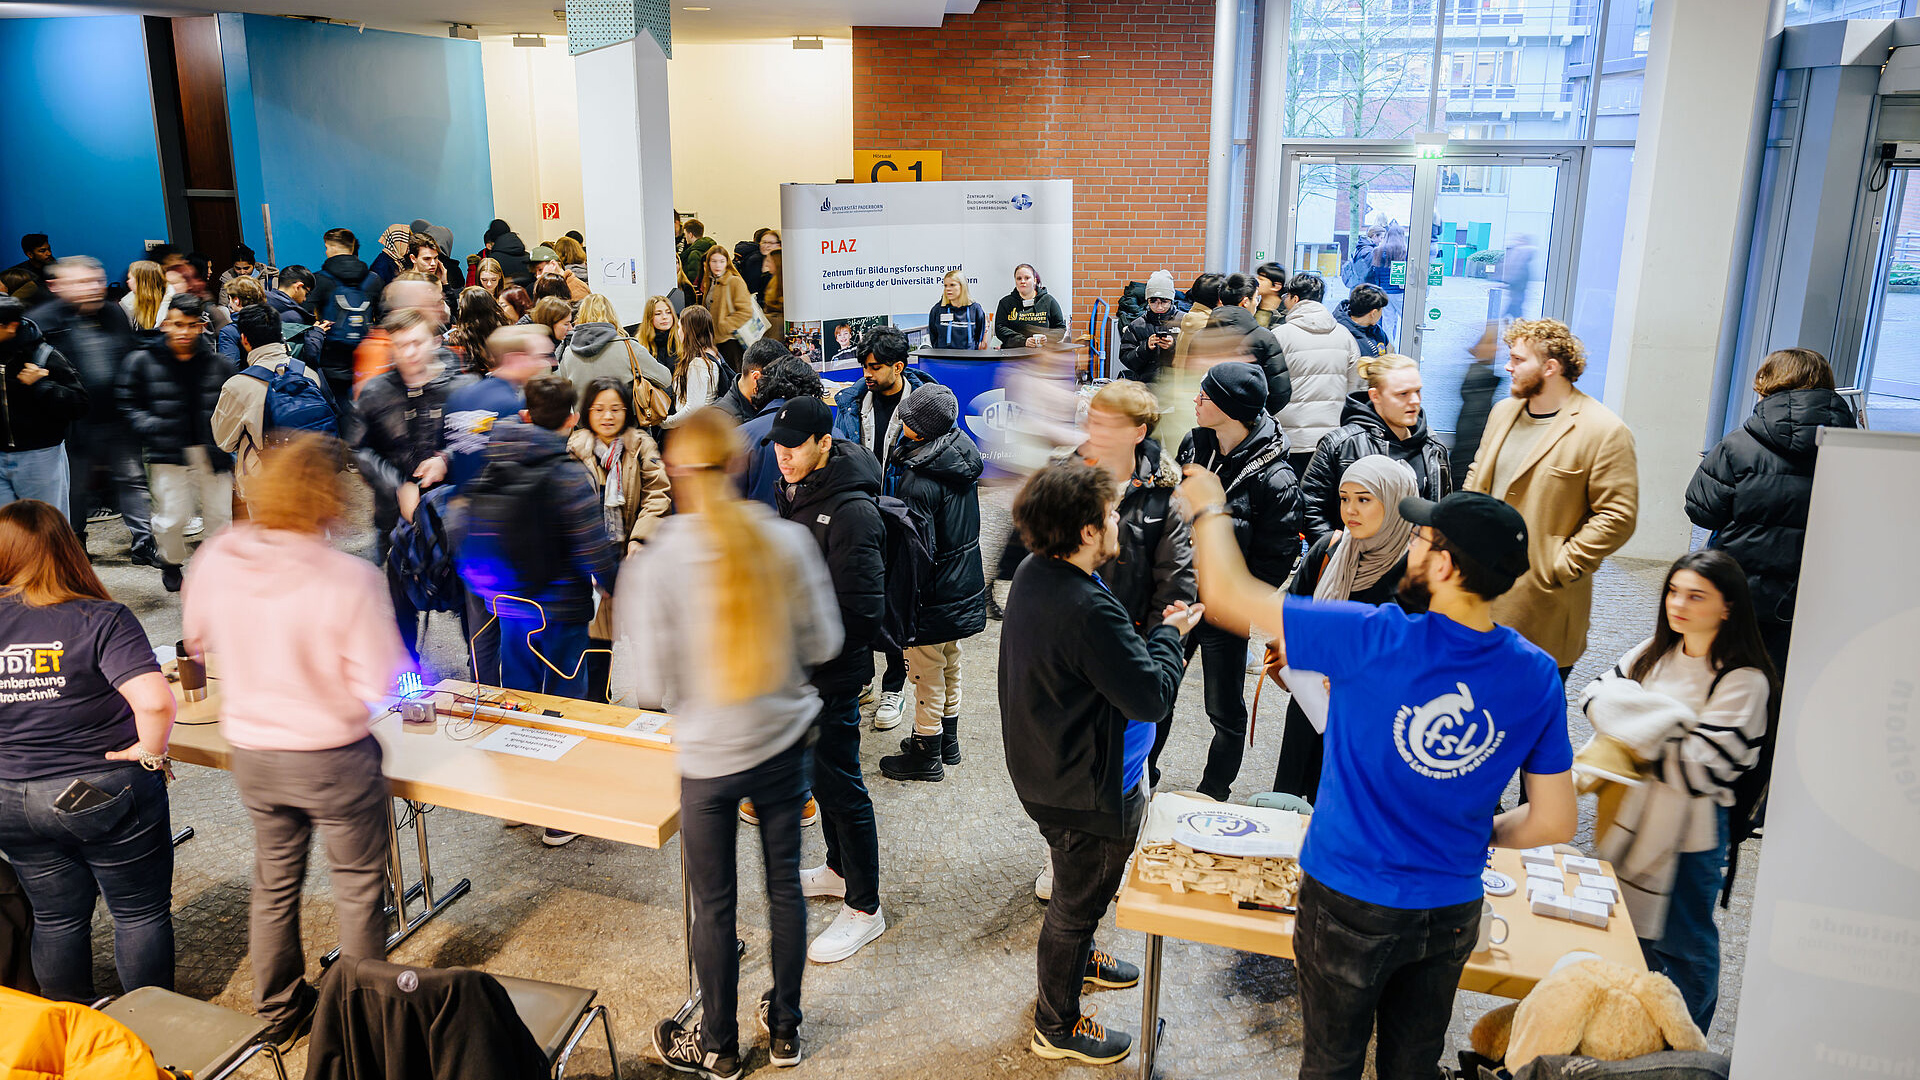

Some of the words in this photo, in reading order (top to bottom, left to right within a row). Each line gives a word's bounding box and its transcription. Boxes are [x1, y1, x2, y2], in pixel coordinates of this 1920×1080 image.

[821, 239, 857, 254] PLAZ
[603, 261, 626, 279] C1
[822, 269, 854, 278] Zentrum
[855, 266, 867, 276] für
[868, 264, 945, 275] Bildungsforschung
[946, 263, 963, 272] und
[822, 278, 875, 291] Lehrerbildung
[875, 278, 889, 287] der
[890, 276, 934, 286] Universität
[936, 276, 978, 285] Paorn
